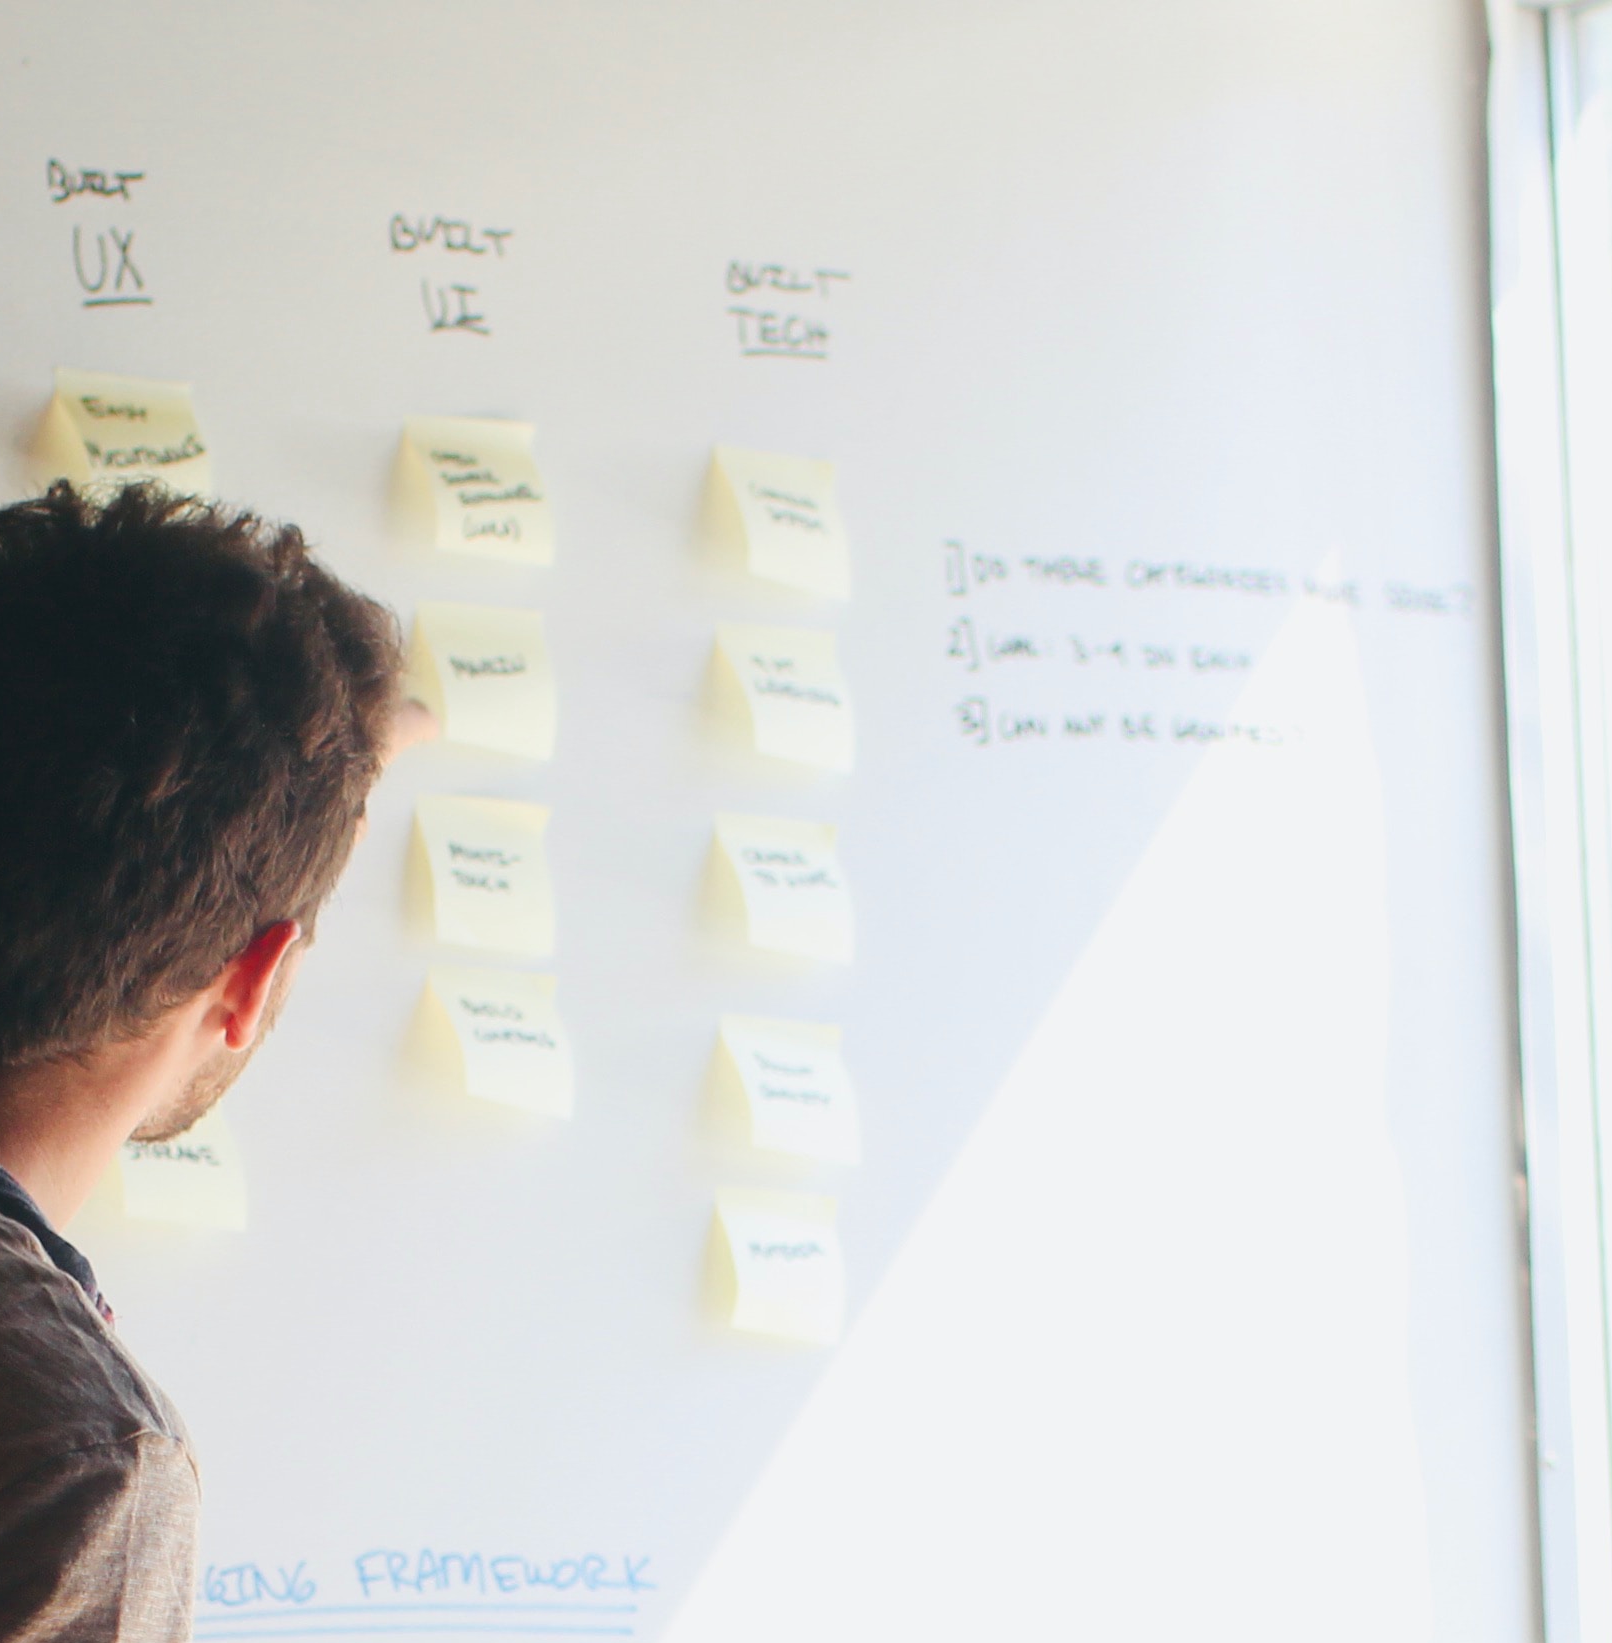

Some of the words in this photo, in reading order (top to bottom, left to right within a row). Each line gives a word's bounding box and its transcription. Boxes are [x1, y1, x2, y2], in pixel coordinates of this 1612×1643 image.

[71, 222, 145, 292] UX
[389, 212, 514, 258] BUILT
[724, 303, 830, 348] TECH
[354, 1546, 660, 1597] FRAMEWORK
